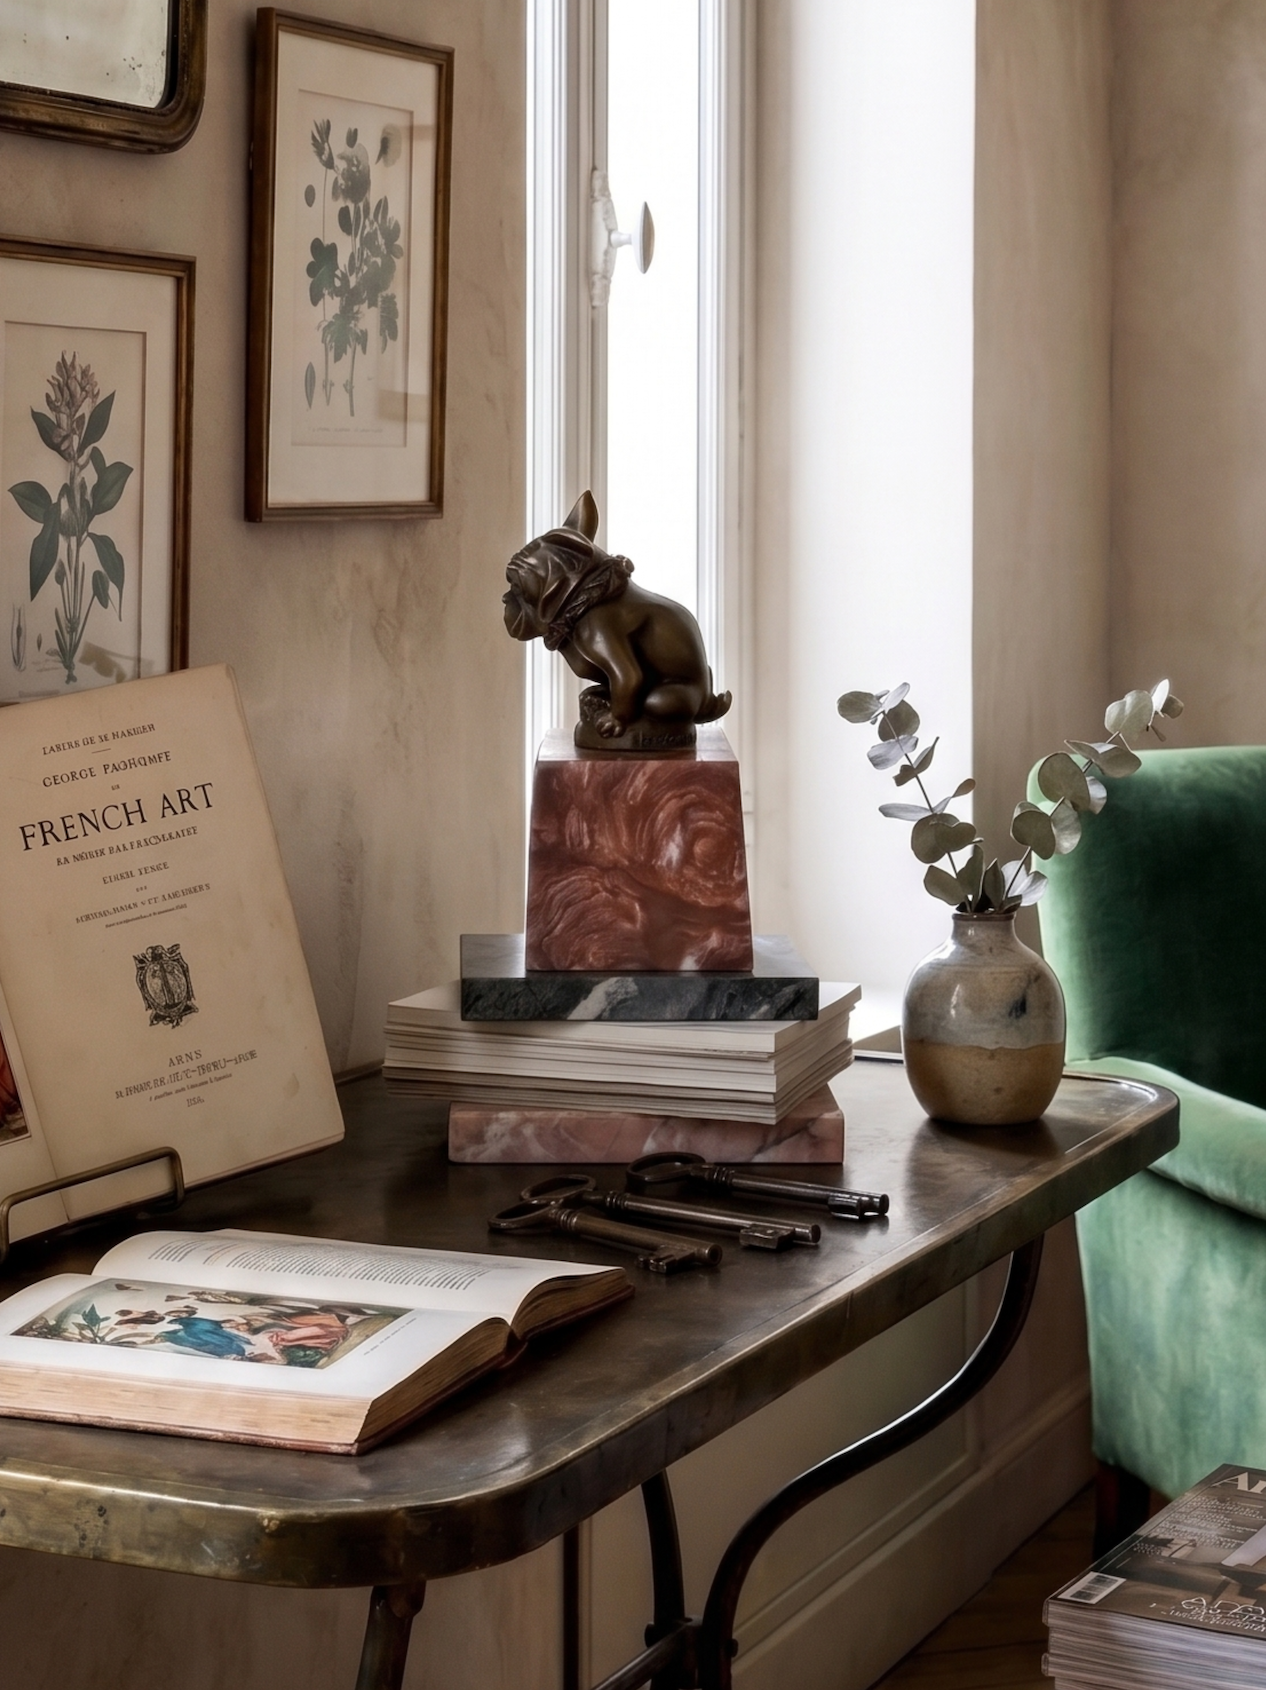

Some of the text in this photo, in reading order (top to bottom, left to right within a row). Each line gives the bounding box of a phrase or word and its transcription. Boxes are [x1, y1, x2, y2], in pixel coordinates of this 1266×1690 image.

[18, 798, 148, 852] FRENCH
[160, 782, 214, 819] ART
[168, 1049, 203, 1068] ARNS
